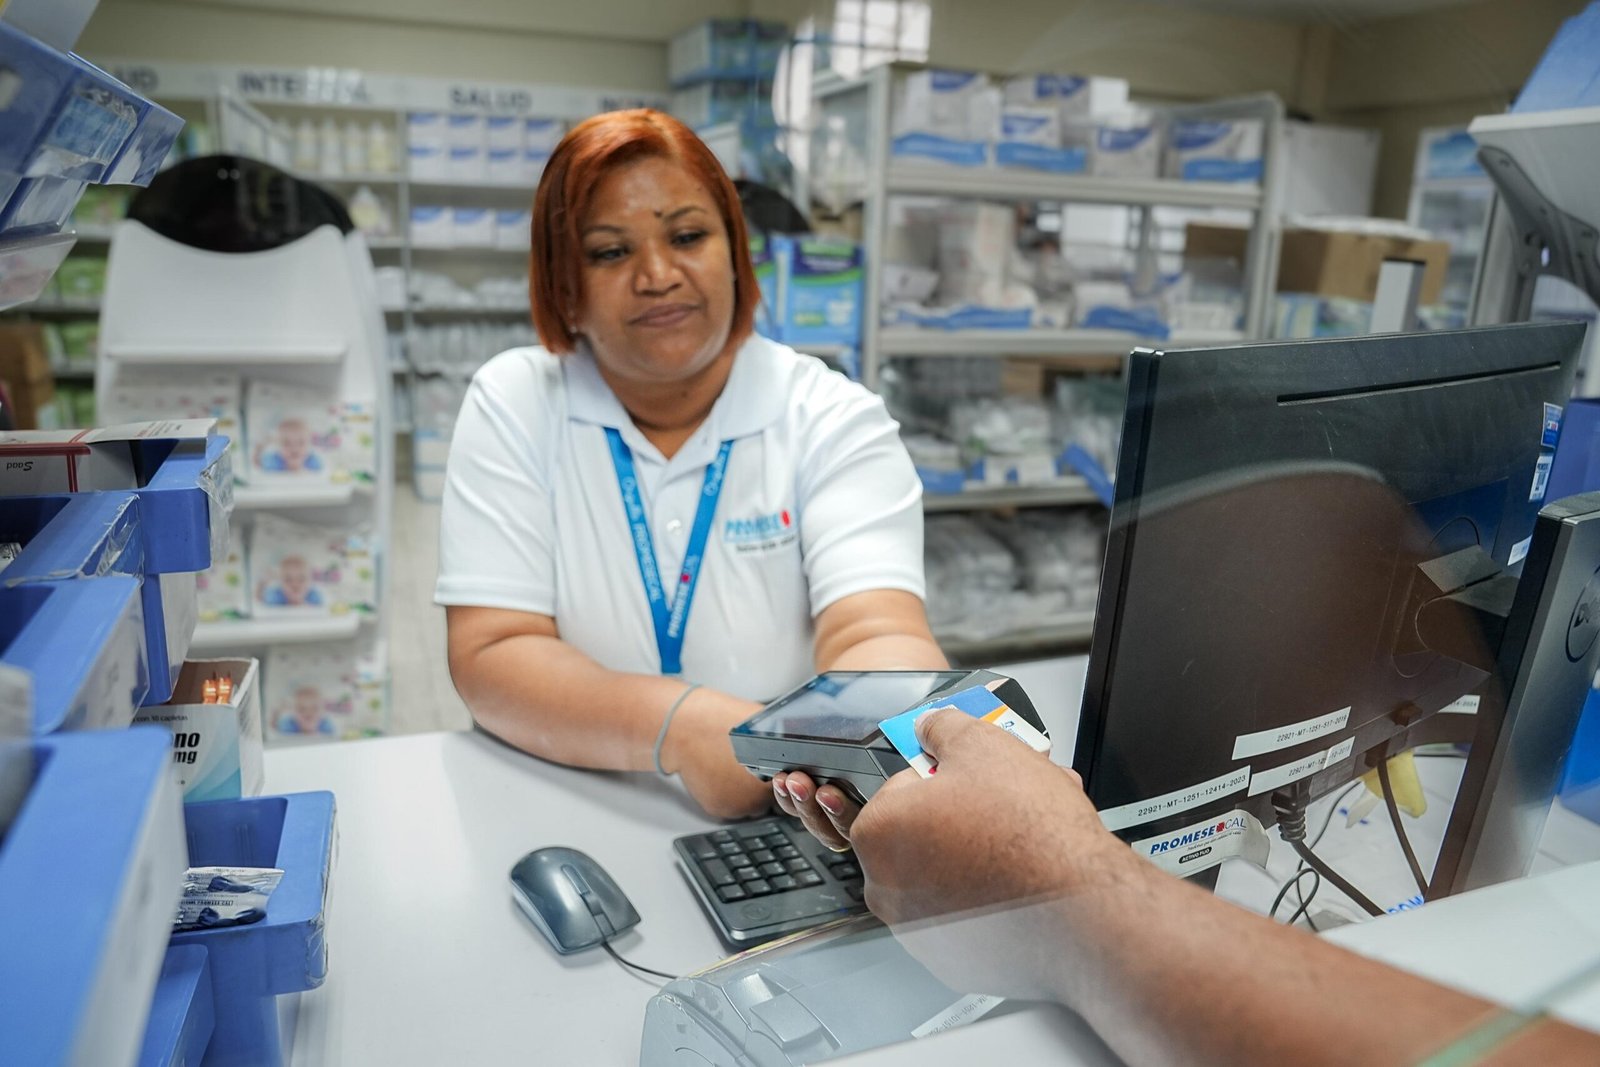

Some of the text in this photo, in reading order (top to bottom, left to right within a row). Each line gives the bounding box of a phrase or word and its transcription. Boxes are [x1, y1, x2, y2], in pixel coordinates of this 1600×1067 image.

[6, 461, 34, 472] Saad
[172, 731, 201, 749] no
[1137, 774, 1247, 817] 22921-MT-1251-12414-2023
[1149, 825, 1216, 856] PROMESE
